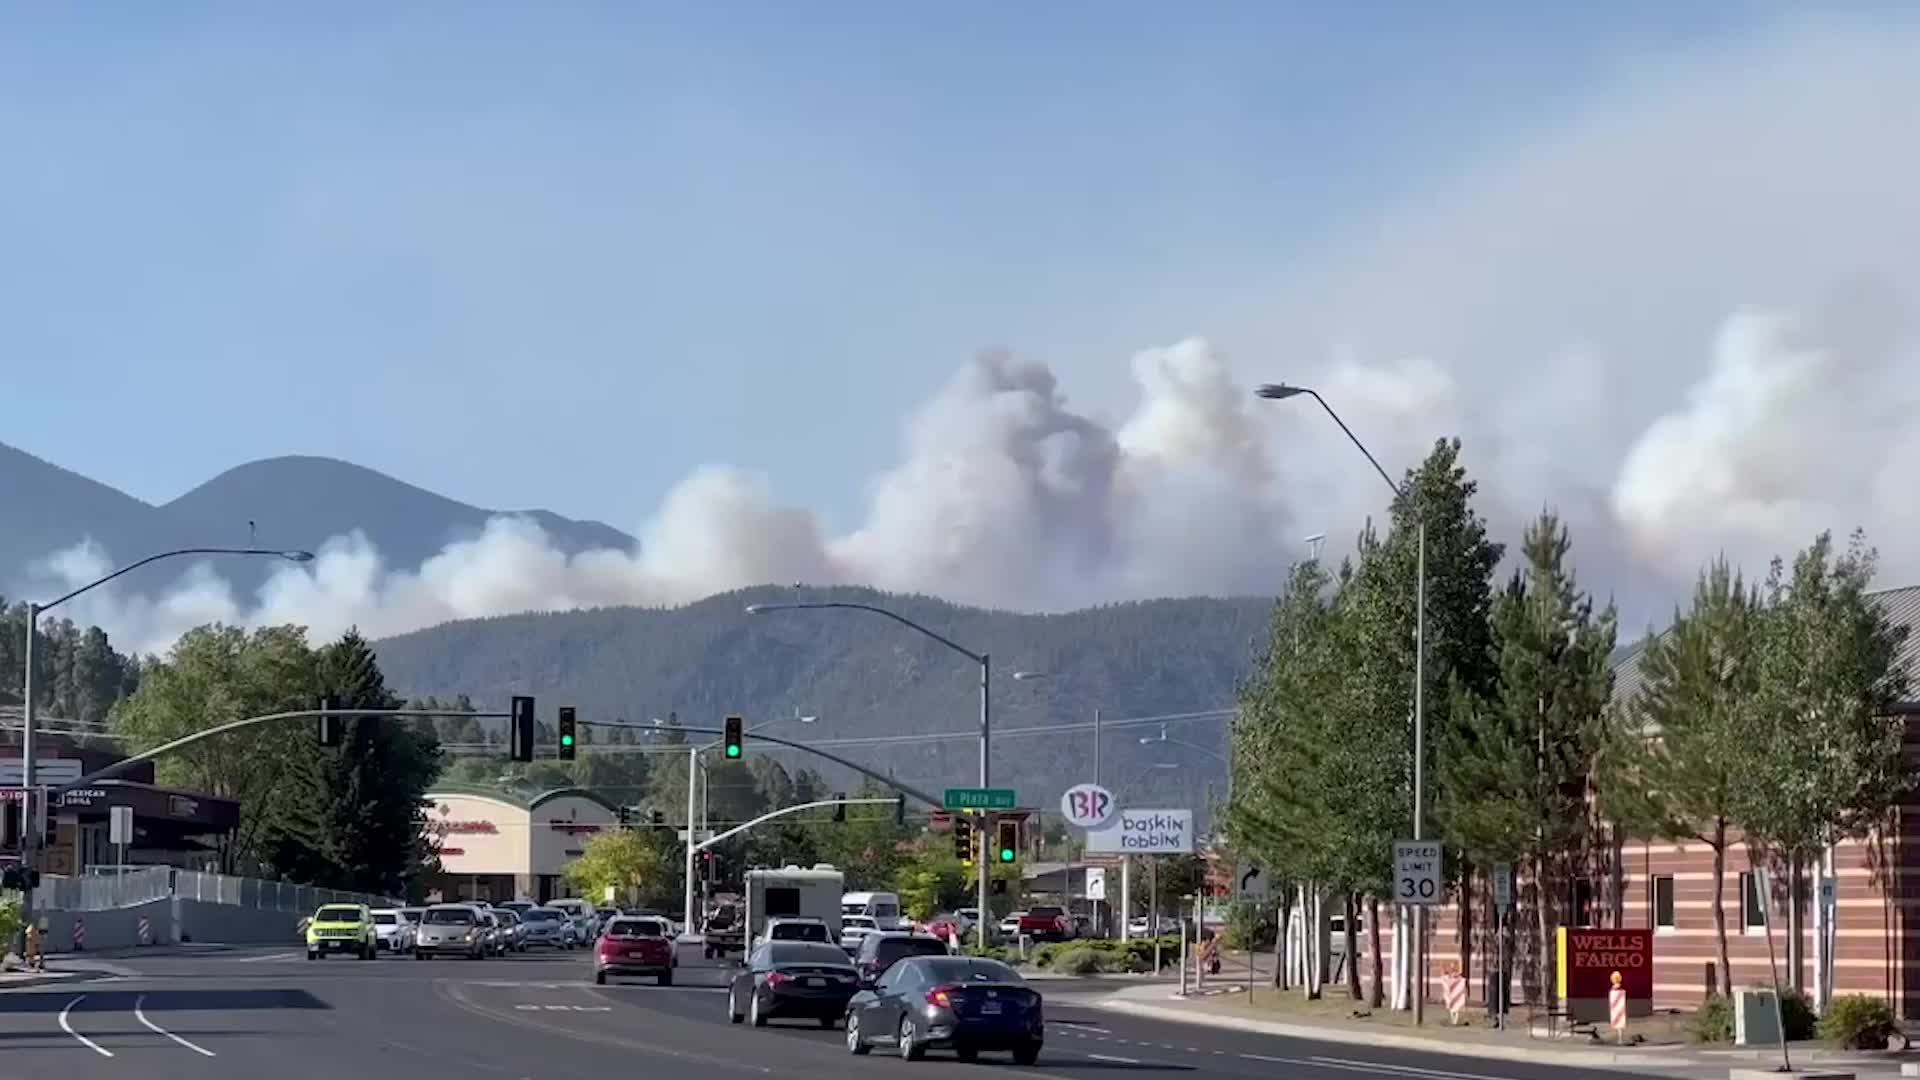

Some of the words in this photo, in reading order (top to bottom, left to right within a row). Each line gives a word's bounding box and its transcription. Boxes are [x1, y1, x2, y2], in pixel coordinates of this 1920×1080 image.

[959, 792, 989, 806] Plaza
[1069, 791, 1109, 818] BR
[1122, 814, 1184, 831] baskin
[1121, 834, 1180, 848] robbins
[1398, 848, 1437, 857] SPEED
[1402, 862, 1432, 872] LIMIT
[1400, 878, 1434, 898] 30
[1573, 935, 1644, 951] WELLS
[1575, 952, 1644, 968] FARGO
